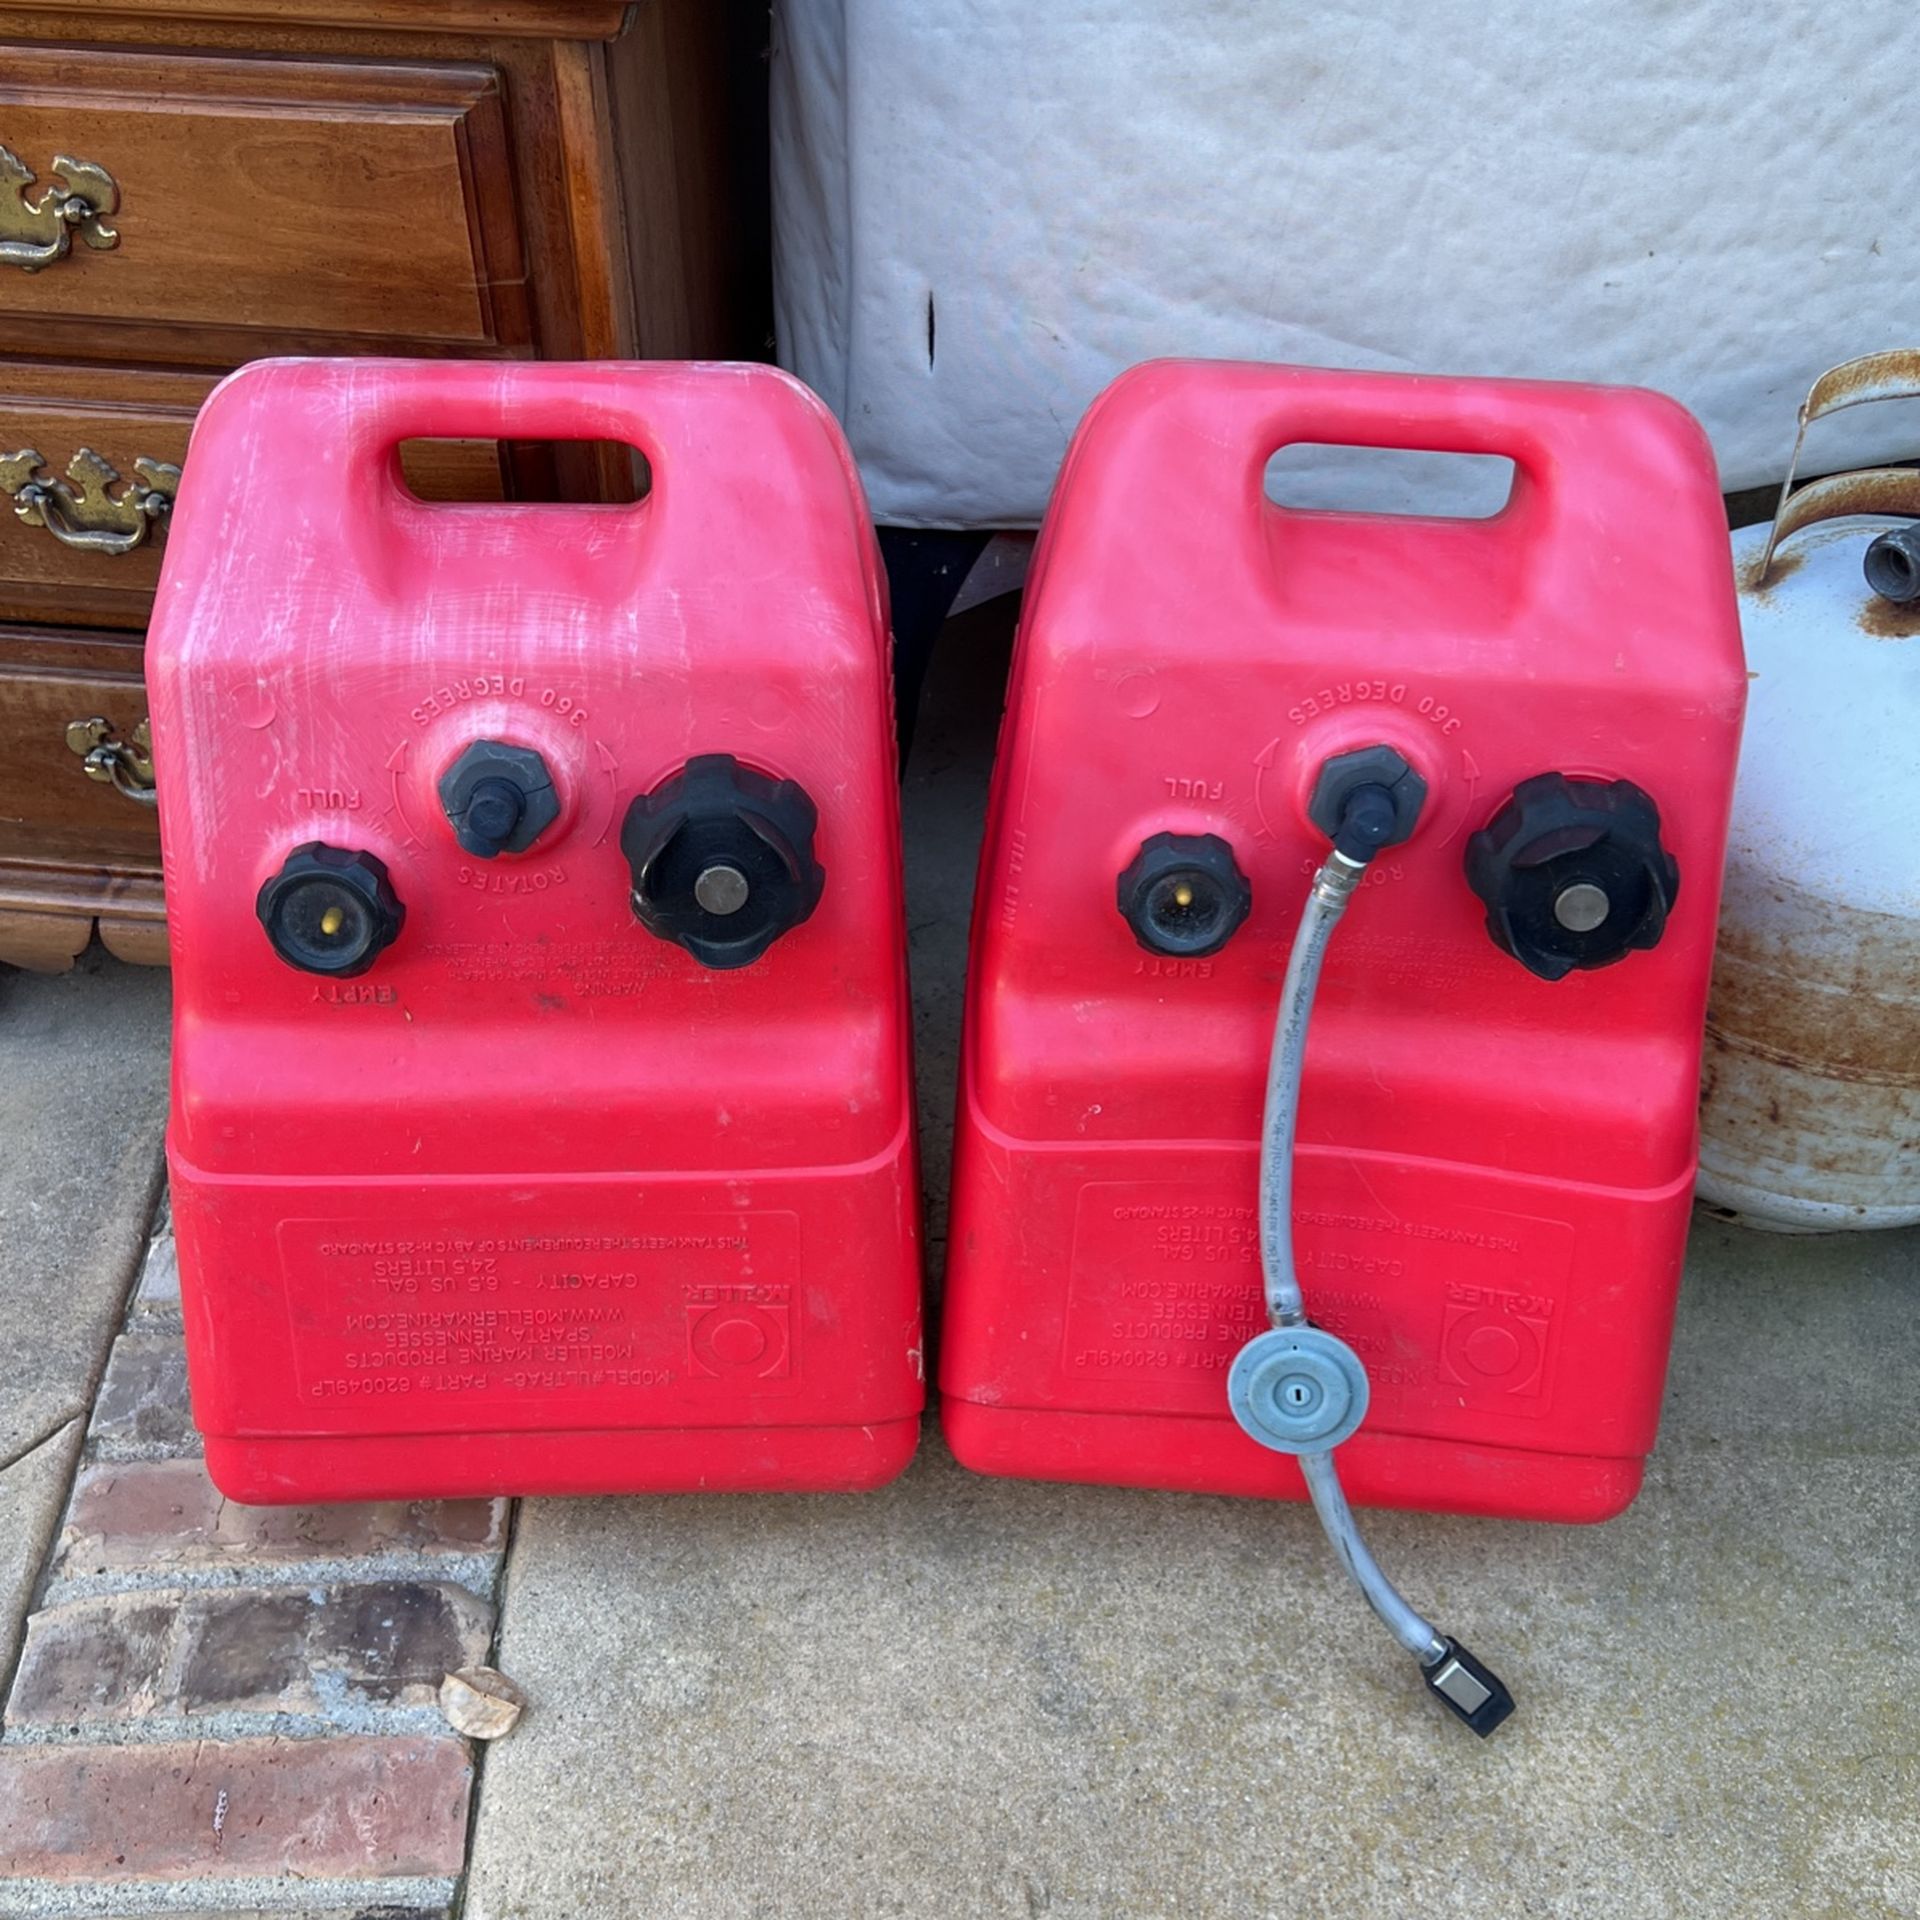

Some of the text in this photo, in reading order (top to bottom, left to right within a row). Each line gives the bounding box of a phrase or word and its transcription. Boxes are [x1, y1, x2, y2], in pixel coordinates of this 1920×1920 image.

[411, 675, 587, 726] 360 DEGREES
[1288, 681, 1461, 735] 360 DEGREES
[1164, 777, 1223, 799] FULL
[298, 787, 360, 808] FULL
[458, 865, 566, 891] ROTATES
[1134, 960, 1212, 977] EMPTY
[308, 985, 397, 1005] EMPTY
[1156, 1225, 1223, 1242] LITERS
[320, 1241, 395, 1256] STANDARD
[437, 1240, 473, 1253] ABYC
[478, 1239, 494, 1252] OF
[1153, 1244, 1194, 1261] GAL.
[1205, 1244, 1228, 1262] US
[373, 1258, 496, 1276] 24.5 LITERS
[1304, 1251, 1404, 1277] CAPACITY
[371, 1277, 418, 1294] GAL.
[431, 1277, 456, 1293] US
[467, 1275, 499, 1292] 6.5
[536, 1272, 638, 1289] CAPACITY
[346, 1307, 624, 1329] WWW.MOELLERMARINE.COM
[1152, 1301, 1254, 1320] TENNESSEE
[384, 1325, 591, 1347] SPARTA, TENNESSEE
[1112, 1322, 1206, 1340] PRODUCTS
[344, 1345, 632, 1368] MOELLER MARINE PRODUCTS
[1074, 1349, 1230, 1369] ART # 620049LP
[311, 1377, 411, 1396] 620049LP
[419, 1376, 431, 1390] #
[436, 1373, 487, 1391] PART
